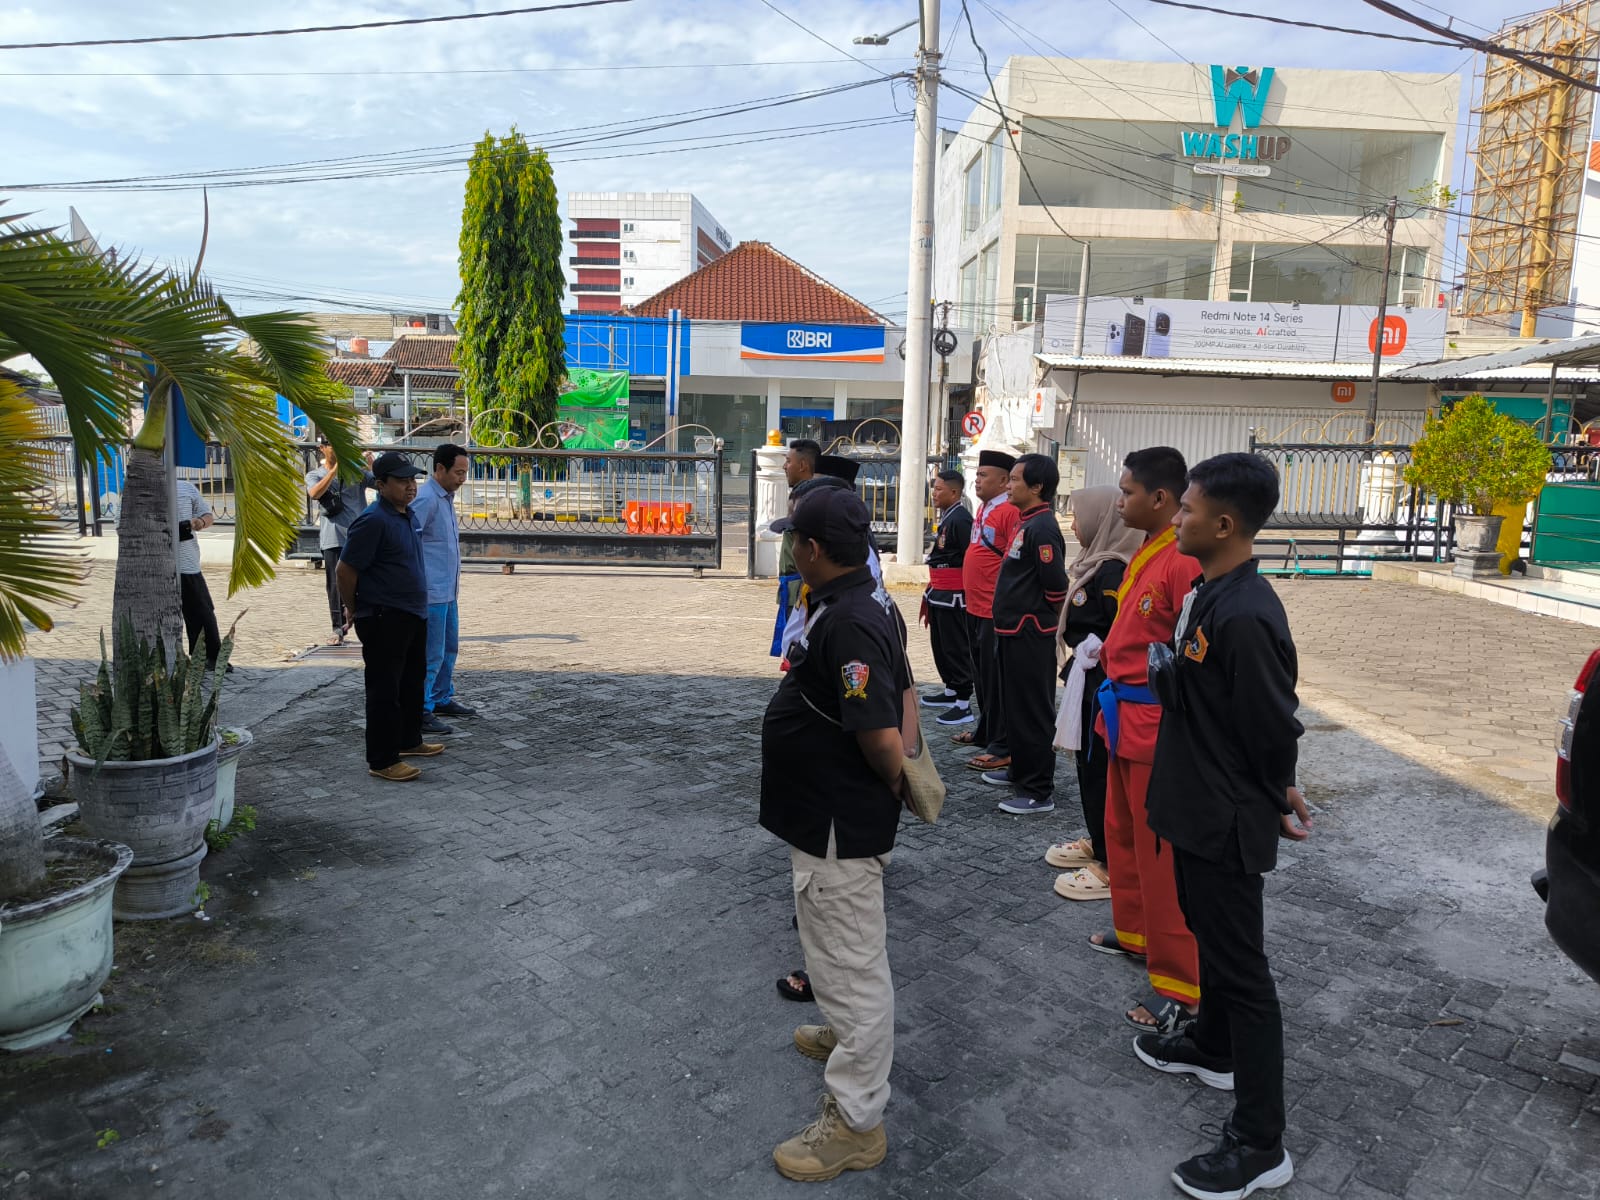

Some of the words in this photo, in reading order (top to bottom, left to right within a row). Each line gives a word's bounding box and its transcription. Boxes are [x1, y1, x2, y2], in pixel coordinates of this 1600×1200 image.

[1201, 310, 1230, 321] Redmi
[1233, 311, 1257, 322] Note
[1260, 312, 1270, 322] 14
[1273, 312, 1304, 324] Series
[805, 332, 832, 348] BRI
